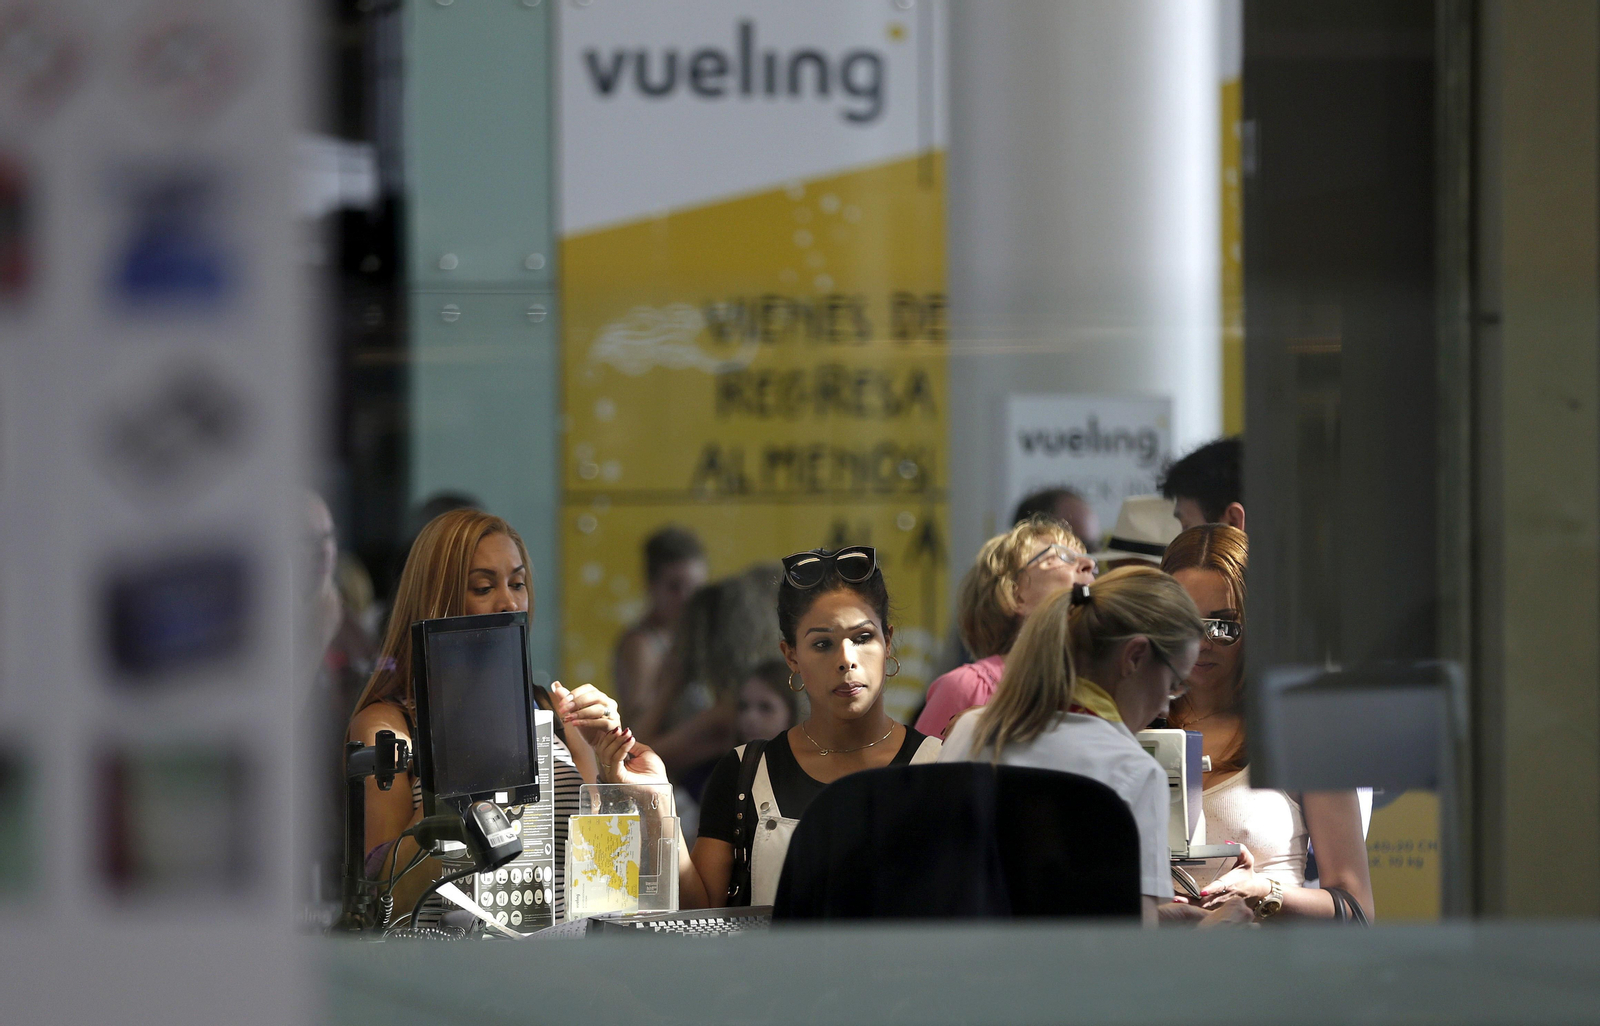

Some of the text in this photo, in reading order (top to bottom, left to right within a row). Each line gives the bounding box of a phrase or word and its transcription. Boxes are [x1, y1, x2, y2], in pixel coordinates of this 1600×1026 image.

[584, 18, 886, 124] vueling
[714, 364, 938, 419] REGRESA
[1017, 412, 1160, 467] vueling
[690, 442, 753, 495] AL
